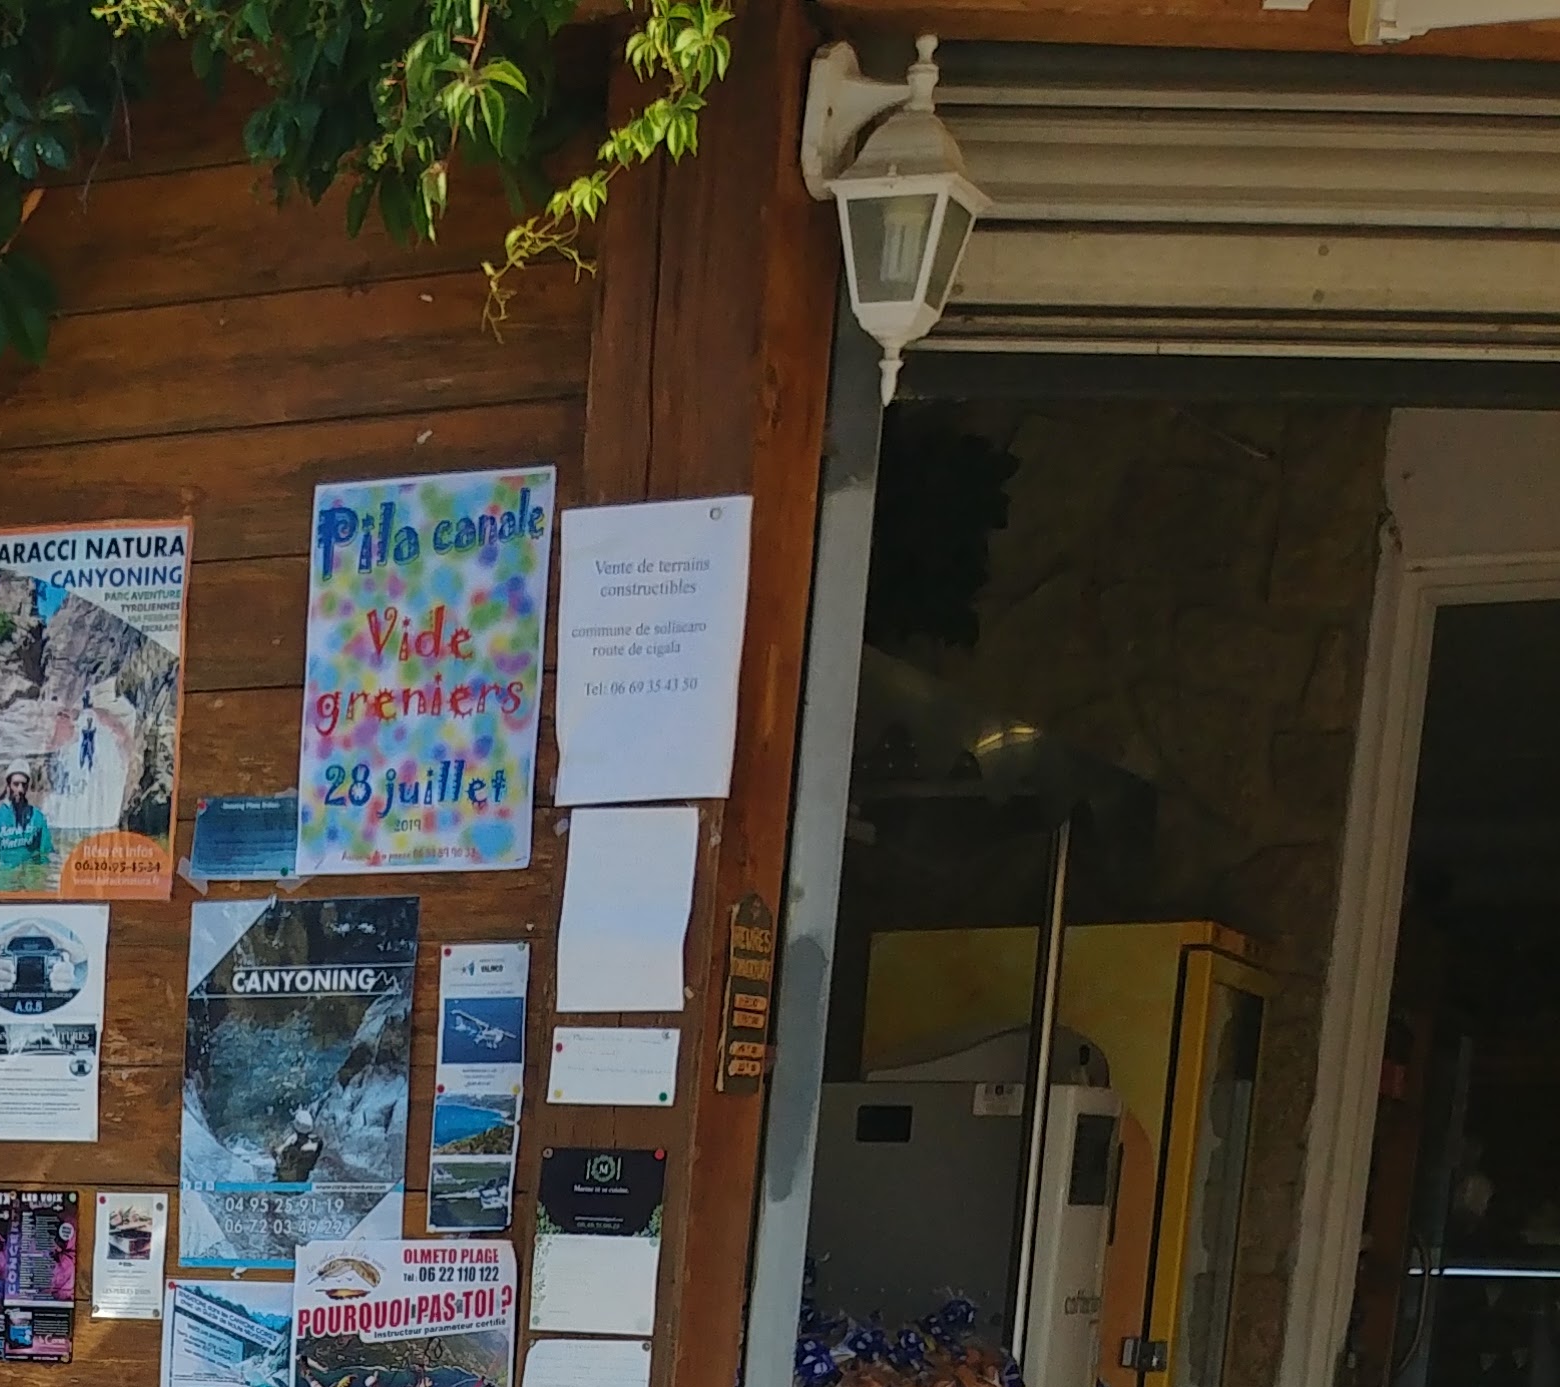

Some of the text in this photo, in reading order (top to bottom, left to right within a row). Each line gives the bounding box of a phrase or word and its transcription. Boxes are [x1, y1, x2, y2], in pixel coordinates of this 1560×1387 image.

[315, 487, 546, 581] Pila canale
[85, 534, 185, 560] NATURA
[50, 565, 182, 589] CANYONING
[595, 556, 710, 576] Vente de terrains
[600, 578, 697, 598] constructibles
[366, 604, 474, 662] Vide
[571, 623, 632, 638] commune
[635, 622, 650, 636] de
[592, 645, 625, 657] route
[628, 643, 642, 656] de
[314, 671, 525, 736] greniers
[323, 758, 507, 818] 28 juillet
[232, 968, 375, 993] CANYONING
[225, 1198, 244, 1214] 04
[249, 1199, 269, 1213] 95
[299, 1198, 316, 1213] 91
[327, 1197, 345, 1212] 19
[225, 1218, 243, 1234] 06
[403, 1248, 457, 1264] OLMETO
[460, 1248, 499, 1264] PLAGE
[418, 1266, 436, 1282] 06
[438, 1266, 454, 1282] 22
[457, 1266, 476, 1282] 110
[479, 1266, 499, 1282] 122
[297, 1297, 411, 1337] POURQUOI
[416, 1291, 457, 1326] PAS
[462, 1287, 495, 1320] TOI
